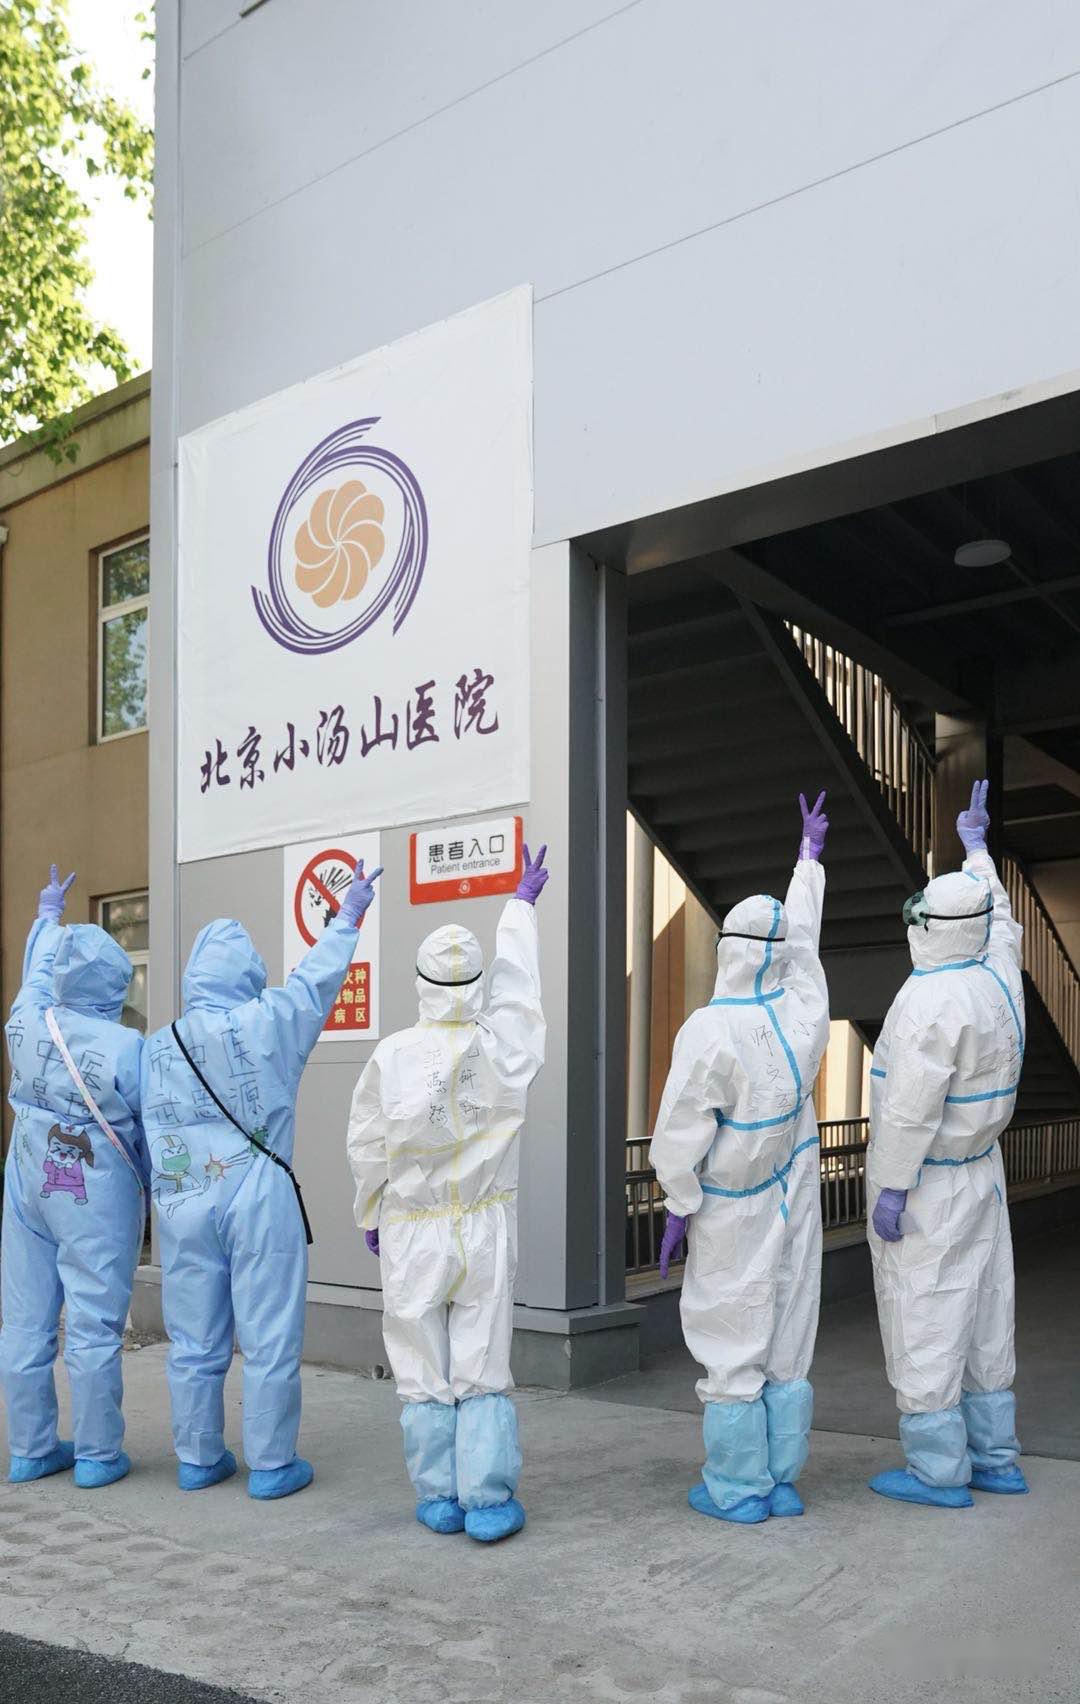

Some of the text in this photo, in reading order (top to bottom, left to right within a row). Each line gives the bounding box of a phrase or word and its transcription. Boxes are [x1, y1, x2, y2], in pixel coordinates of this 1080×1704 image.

[200, 668, 499, 793] 北京小汤山医院
[428, 834, 504, 863] 患者入口
[431, 857, 501, 875] Patient entrance
